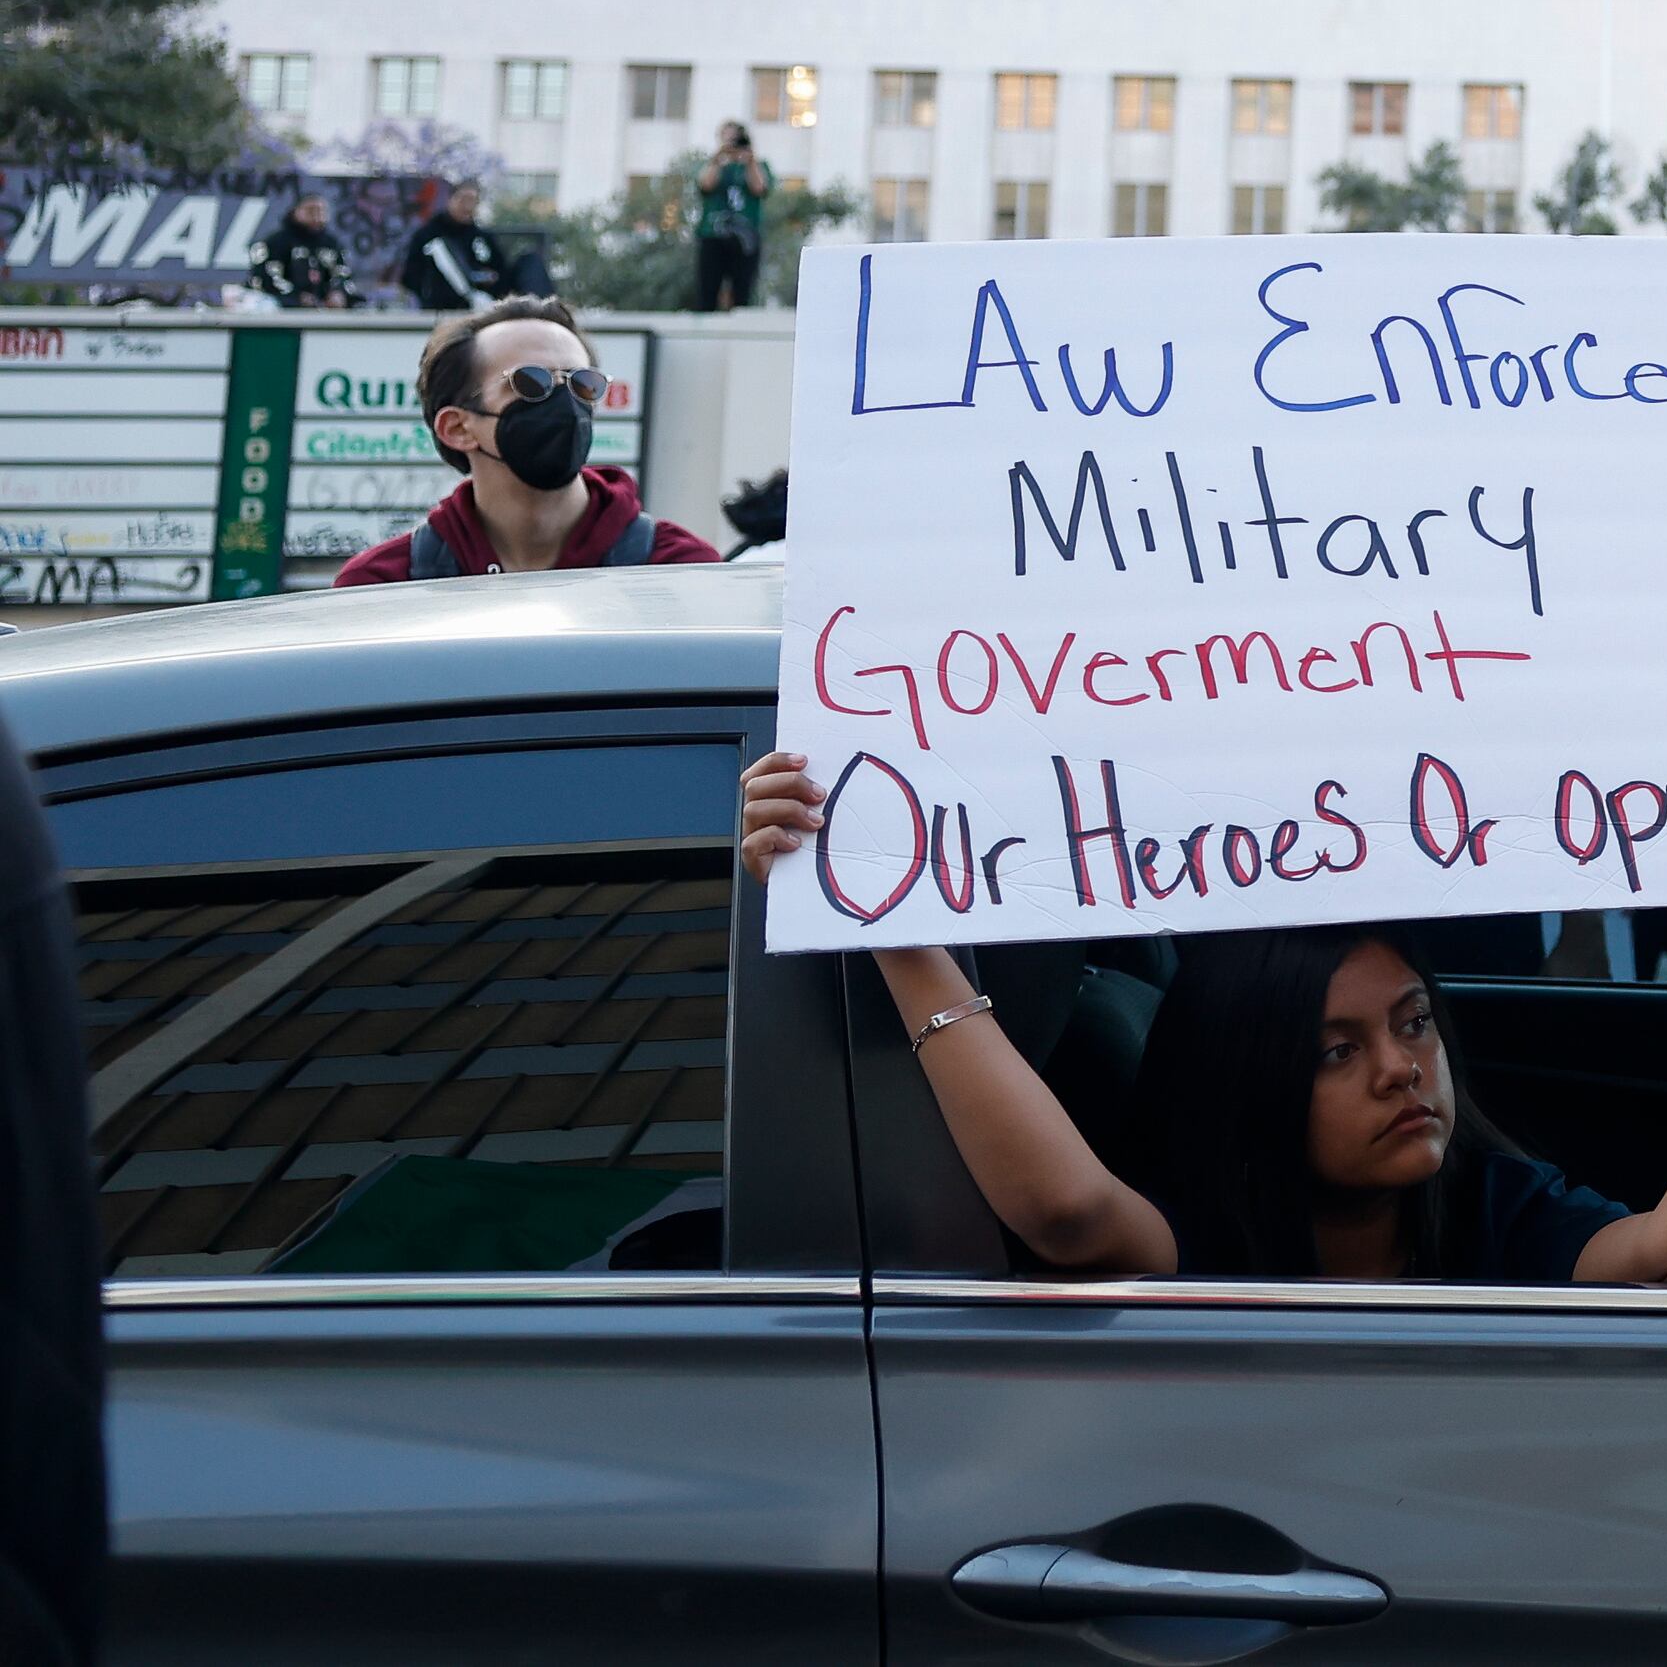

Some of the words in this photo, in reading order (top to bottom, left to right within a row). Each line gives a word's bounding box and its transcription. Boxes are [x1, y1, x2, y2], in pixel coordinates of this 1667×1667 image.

[317, 371, 421, 408] Qui
[239, 407, 270, 523] FOOD
[1008, 445, 1545, 617] Military
[816, 750, 1026, 925] Our
[1051, 753, 1367, 910] Heroes
[1409, 751, 1499, 870] Or
